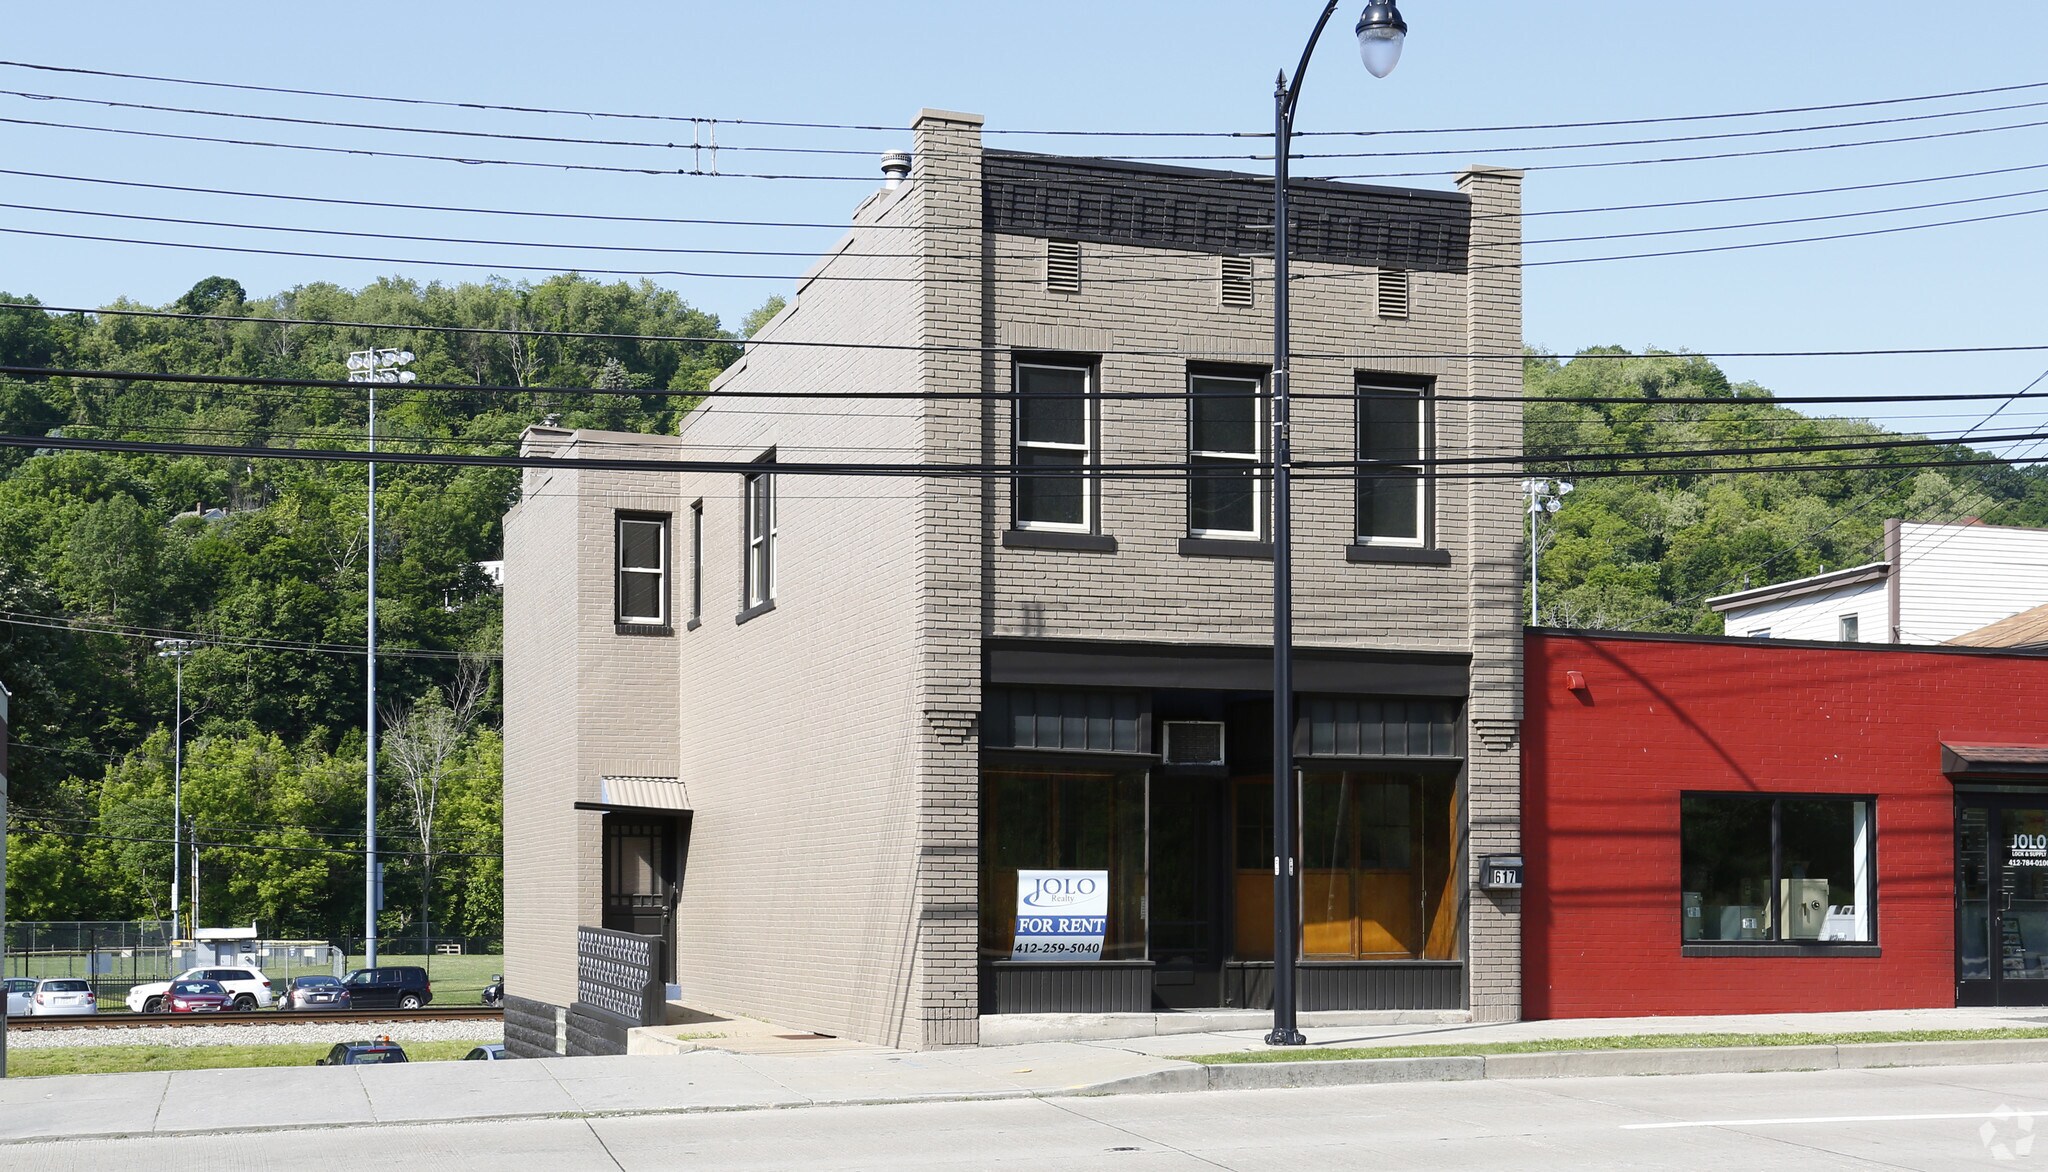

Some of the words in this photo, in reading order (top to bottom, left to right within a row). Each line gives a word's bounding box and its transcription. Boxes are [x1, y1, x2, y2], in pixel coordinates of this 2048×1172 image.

[2011, 834, 2047, 849] JOLO
[1495, 871, 1515, 883] 617
[1033, 878, 1096, 903] JOLO
[1051, 895, 1074, 903] Realty
[1017, 918, 1054, 933] FOR
[1057, 918, 1105, 933] RENT
[1015, 943, 1099, 953] 412-259-5040
